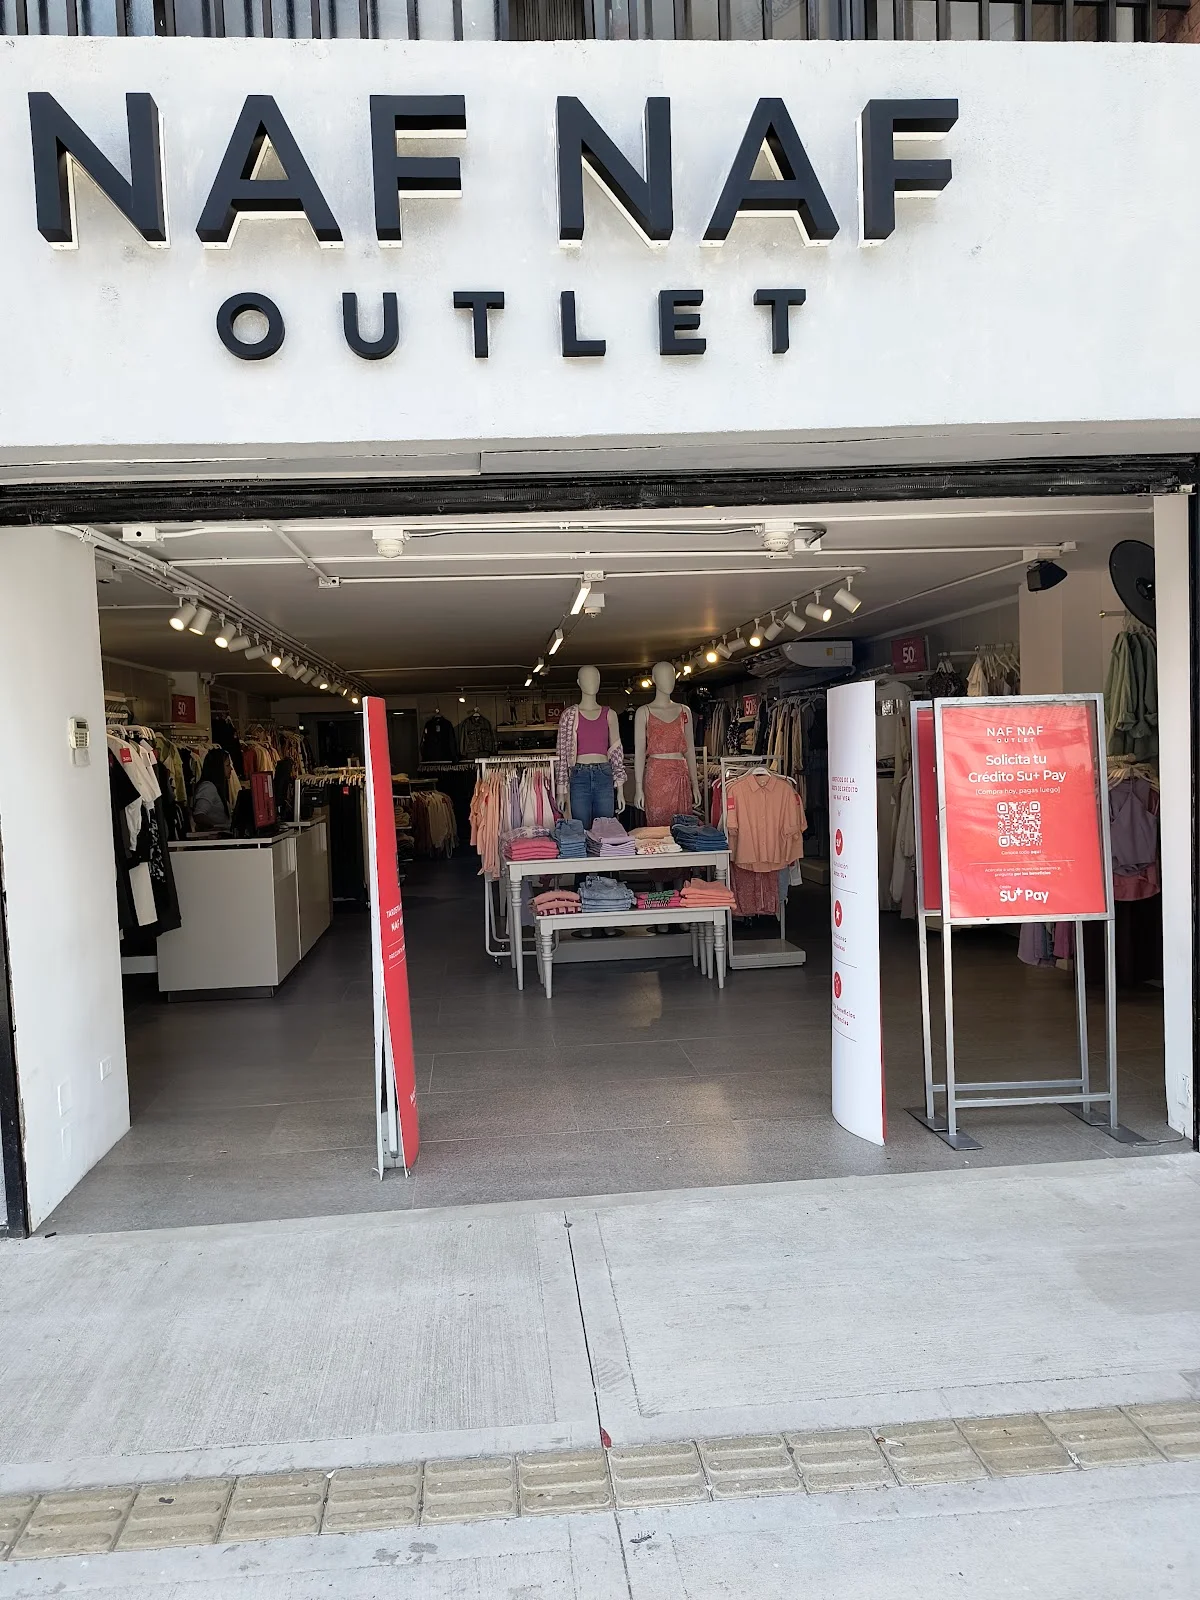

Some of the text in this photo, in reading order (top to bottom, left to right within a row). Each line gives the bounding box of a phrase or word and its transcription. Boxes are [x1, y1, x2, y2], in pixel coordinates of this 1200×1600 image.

[28, 92, 959, 249] NAF NAF
[216, 289, 806, 361] OUTLET
[986, 726, 1044, 737] NAF NAF
[985, 754, 1047, 766] Solicita tu
[968, 769, 1067, 783] Crédito Su+ Pay
[1024, 889, 1049, 904] Pay
